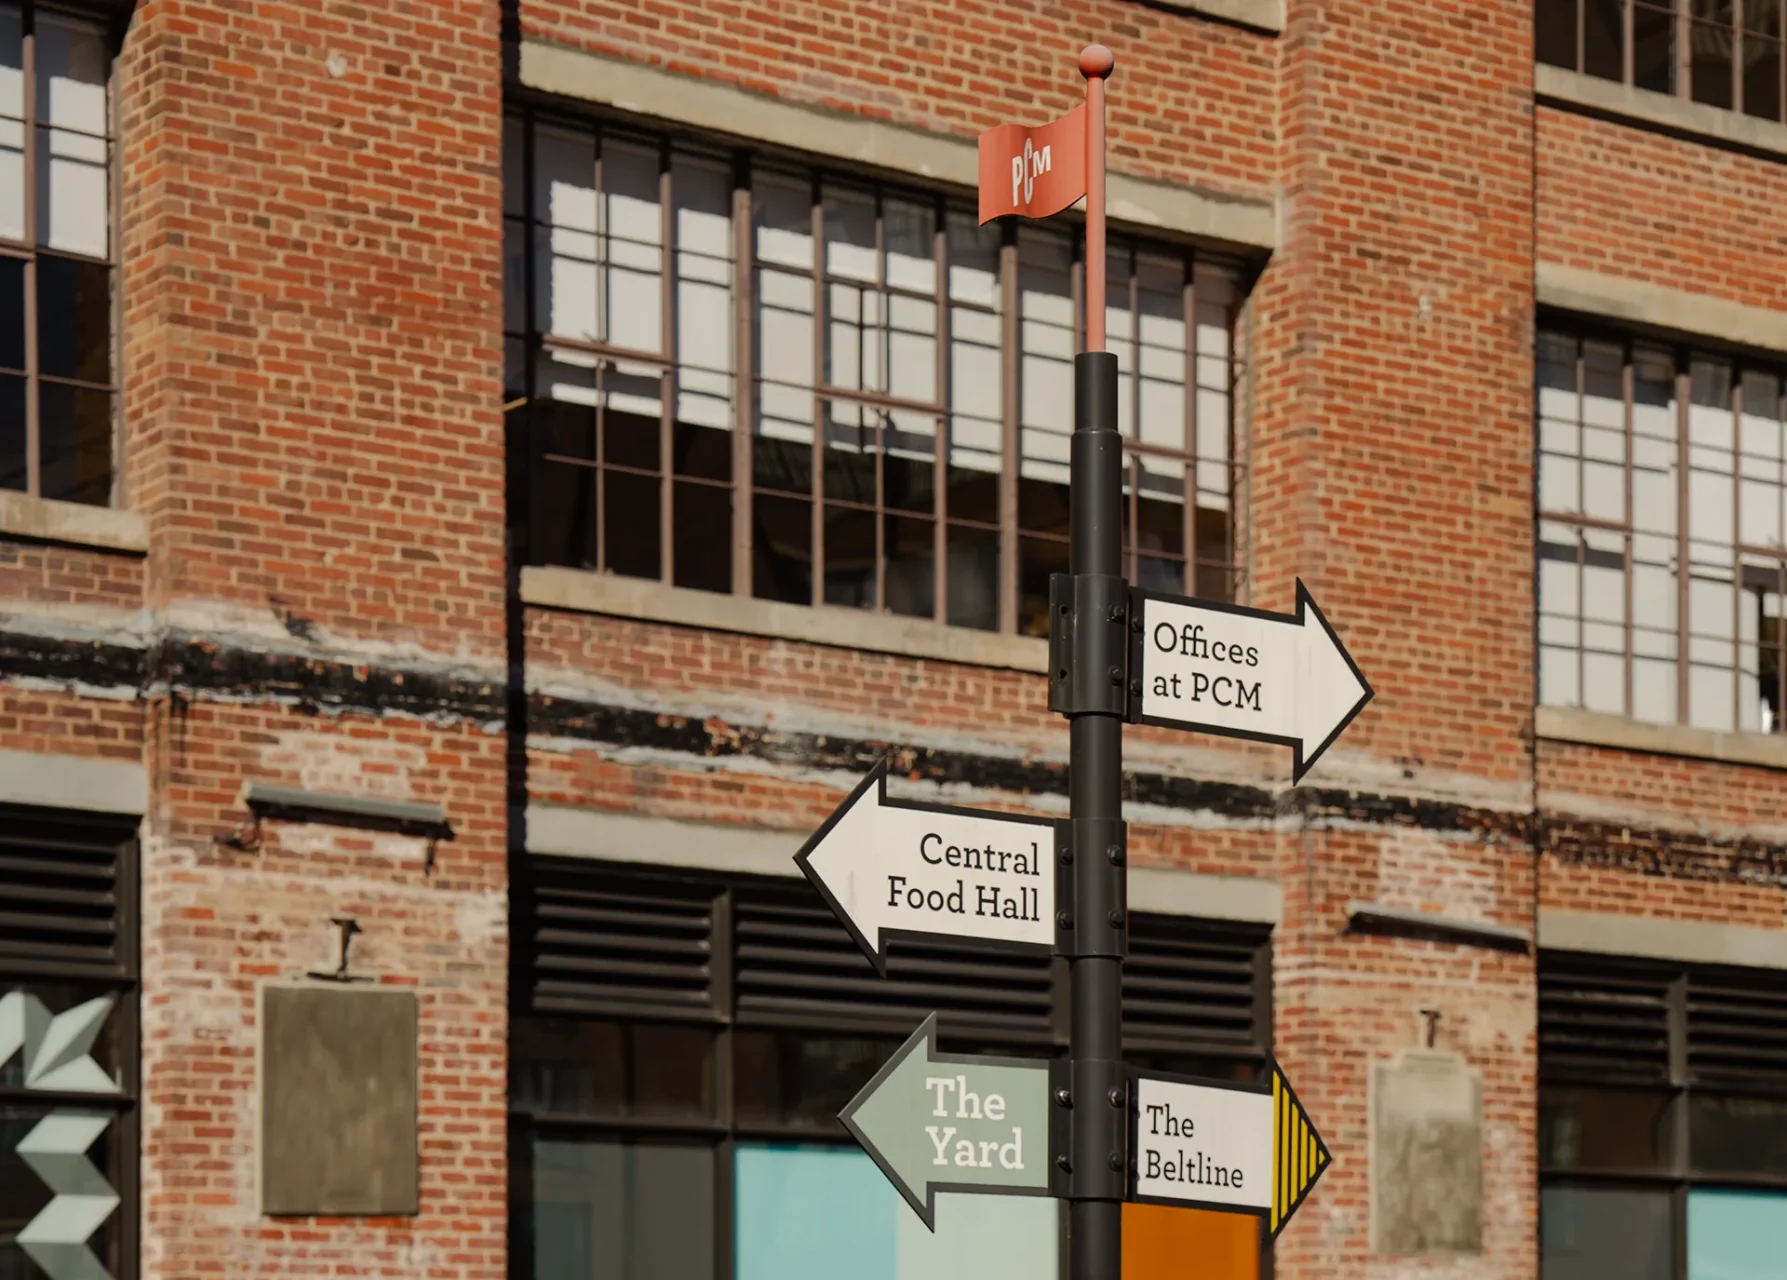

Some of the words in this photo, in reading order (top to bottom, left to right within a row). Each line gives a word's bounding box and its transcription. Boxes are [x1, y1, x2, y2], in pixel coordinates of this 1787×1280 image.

[1012, 137, 1051, 207] PCM
[1154, 622, 1258, 667] Offices
[1153, 673, 1181, 699] at
[1191, 672, 1262, 712] PCM
[920, 833, 1040, 876] Central
[888, 875, 965, 914] Food
[975, 885, 1040, 922] Hall
[926, 1075, 1006, 1120] The
[1146, 1103, 1194, 1138] The
[925, 1125, 1025, 1170] Yard
[1145, 1149, 1244, 1188] Beltline
